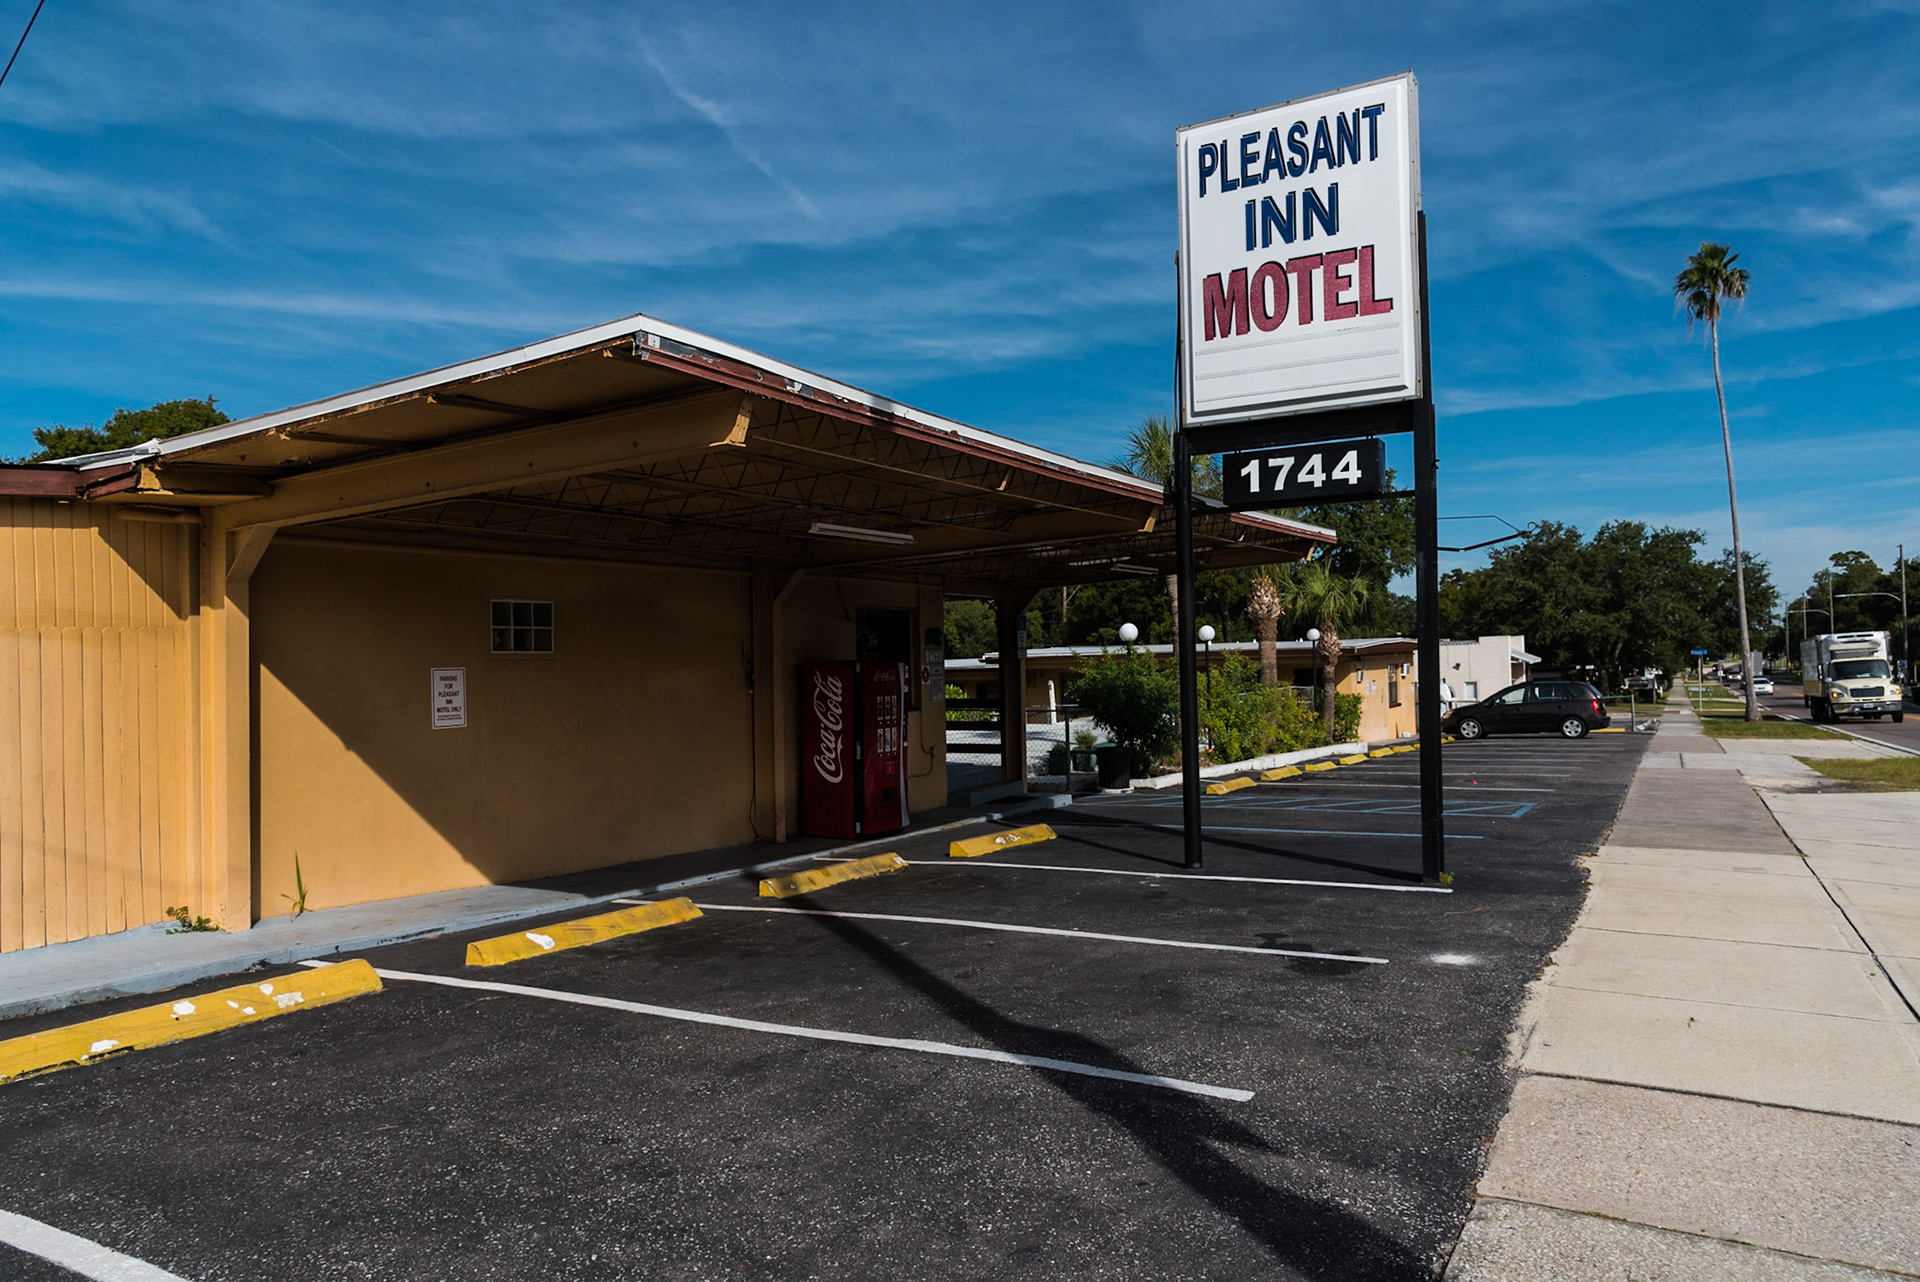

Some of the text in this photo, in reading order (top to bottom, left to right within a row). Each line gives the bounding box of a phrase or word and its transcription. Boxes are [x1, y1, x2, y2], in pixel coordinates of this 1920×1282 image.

[1199, 103, 1385, 198] PLEASANT
[1245, 182, 1339, 252] INN
[1202, 245, 1394, 342] MOTEL
[1240, 449, 1362, 493] 1744
[814, 669, 843, 784] Coca-Cola
